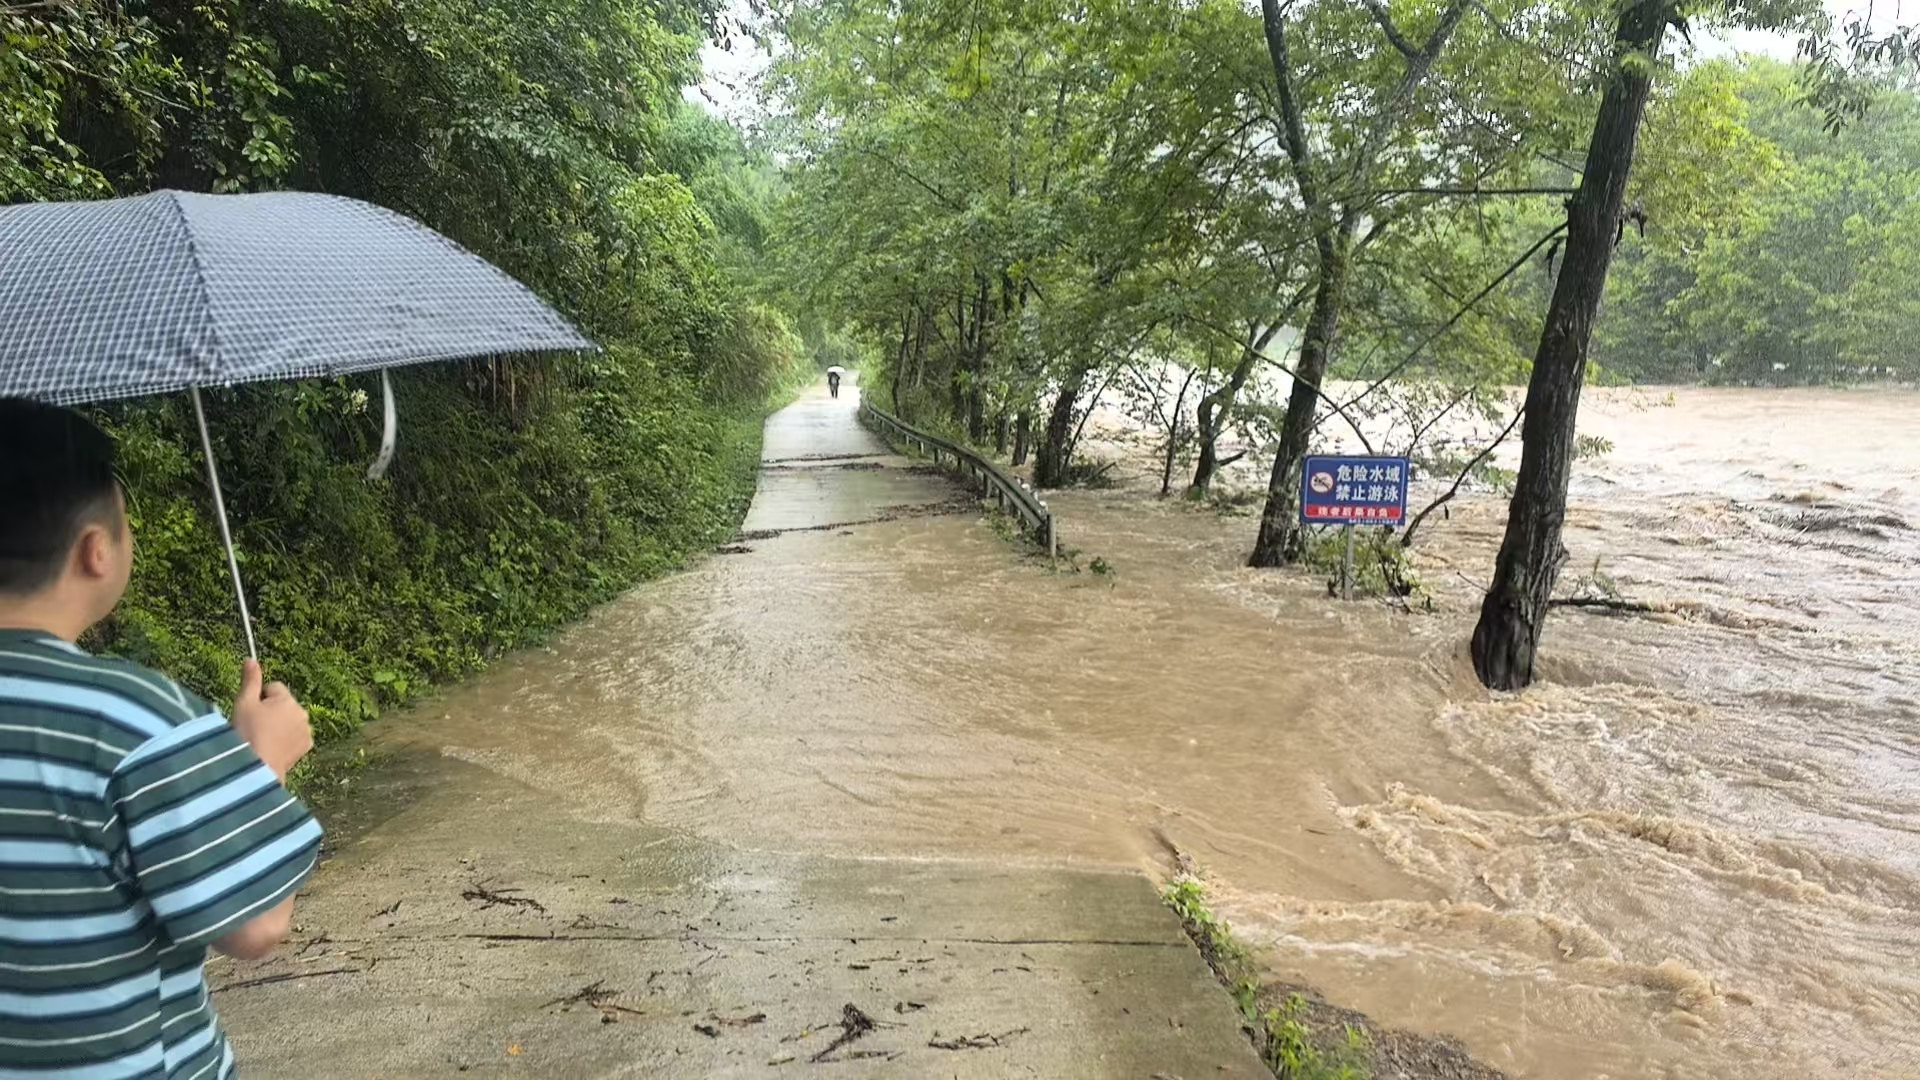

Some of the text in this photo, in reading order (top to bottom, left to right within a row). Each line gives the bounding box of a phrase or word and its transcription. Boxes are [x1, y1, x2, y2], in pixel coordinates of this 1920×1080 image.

[1337, 464, 1400, 482] 危险水域
[1336, 484, 1399, 502] 禁止游泳
